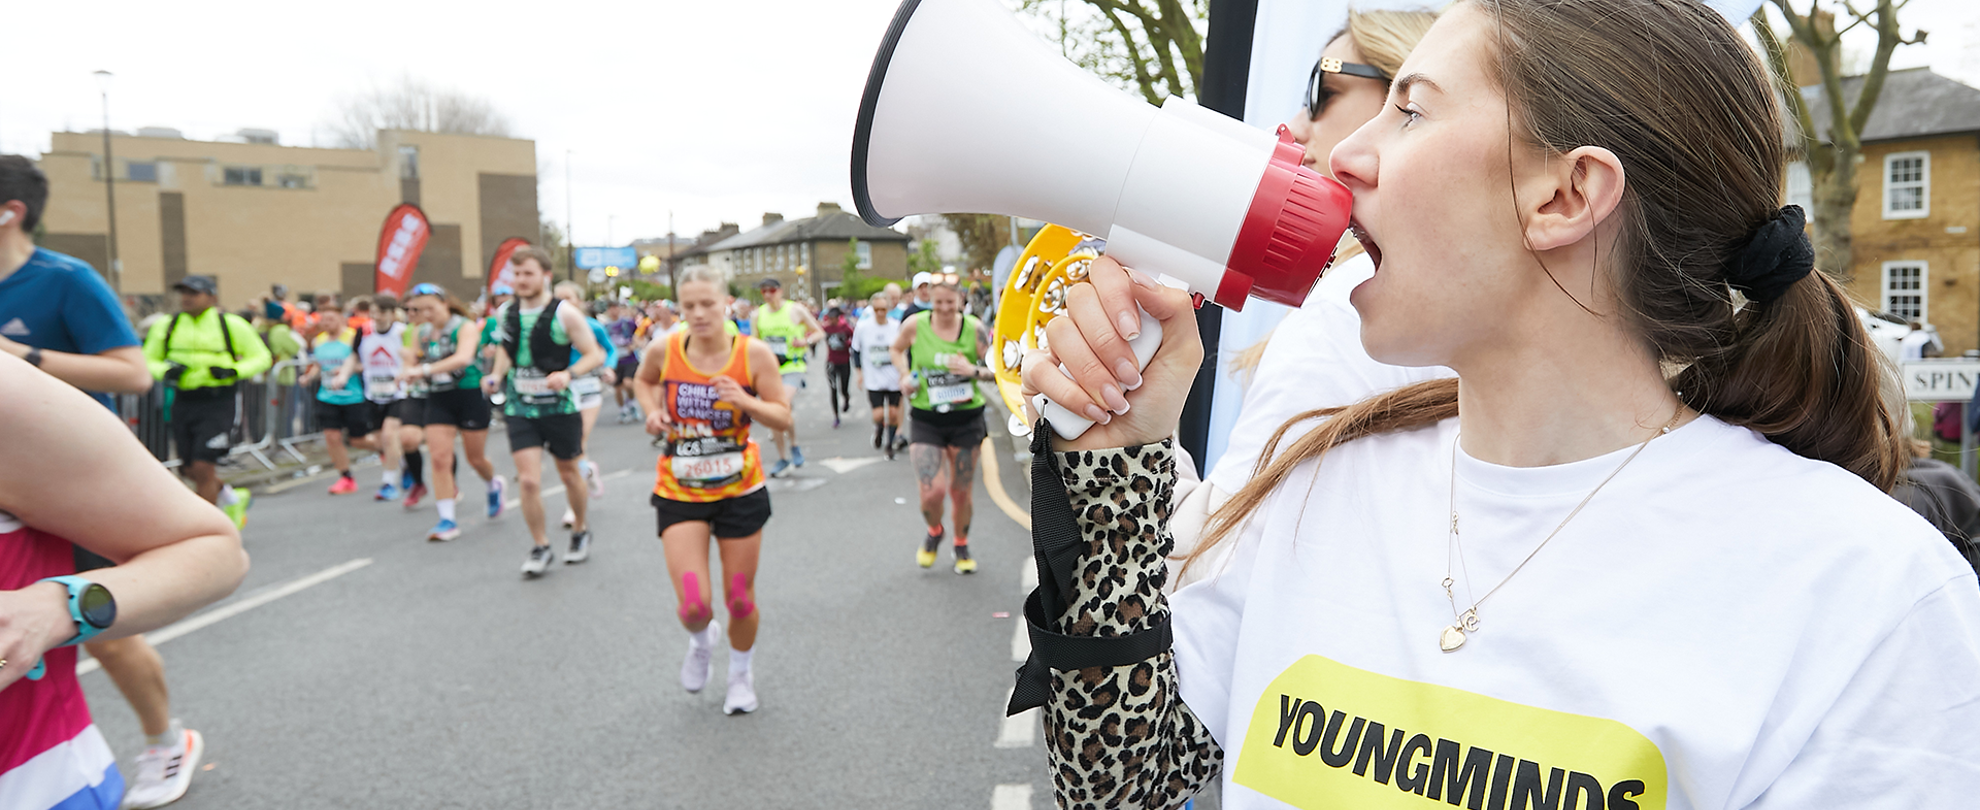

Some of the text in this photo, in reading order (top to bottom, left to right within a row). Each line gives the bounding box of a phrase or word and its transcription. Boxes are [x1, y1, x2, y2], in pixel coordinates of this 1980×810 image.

[678, 383, 720, 400] CHILD
[677, 395, 711, 408] WITH
[677, 407, 732, 420] CANCER
[684, 458, 732, 477] 26015
[1273, 693, 1647, 810] YOUNGMINDS
